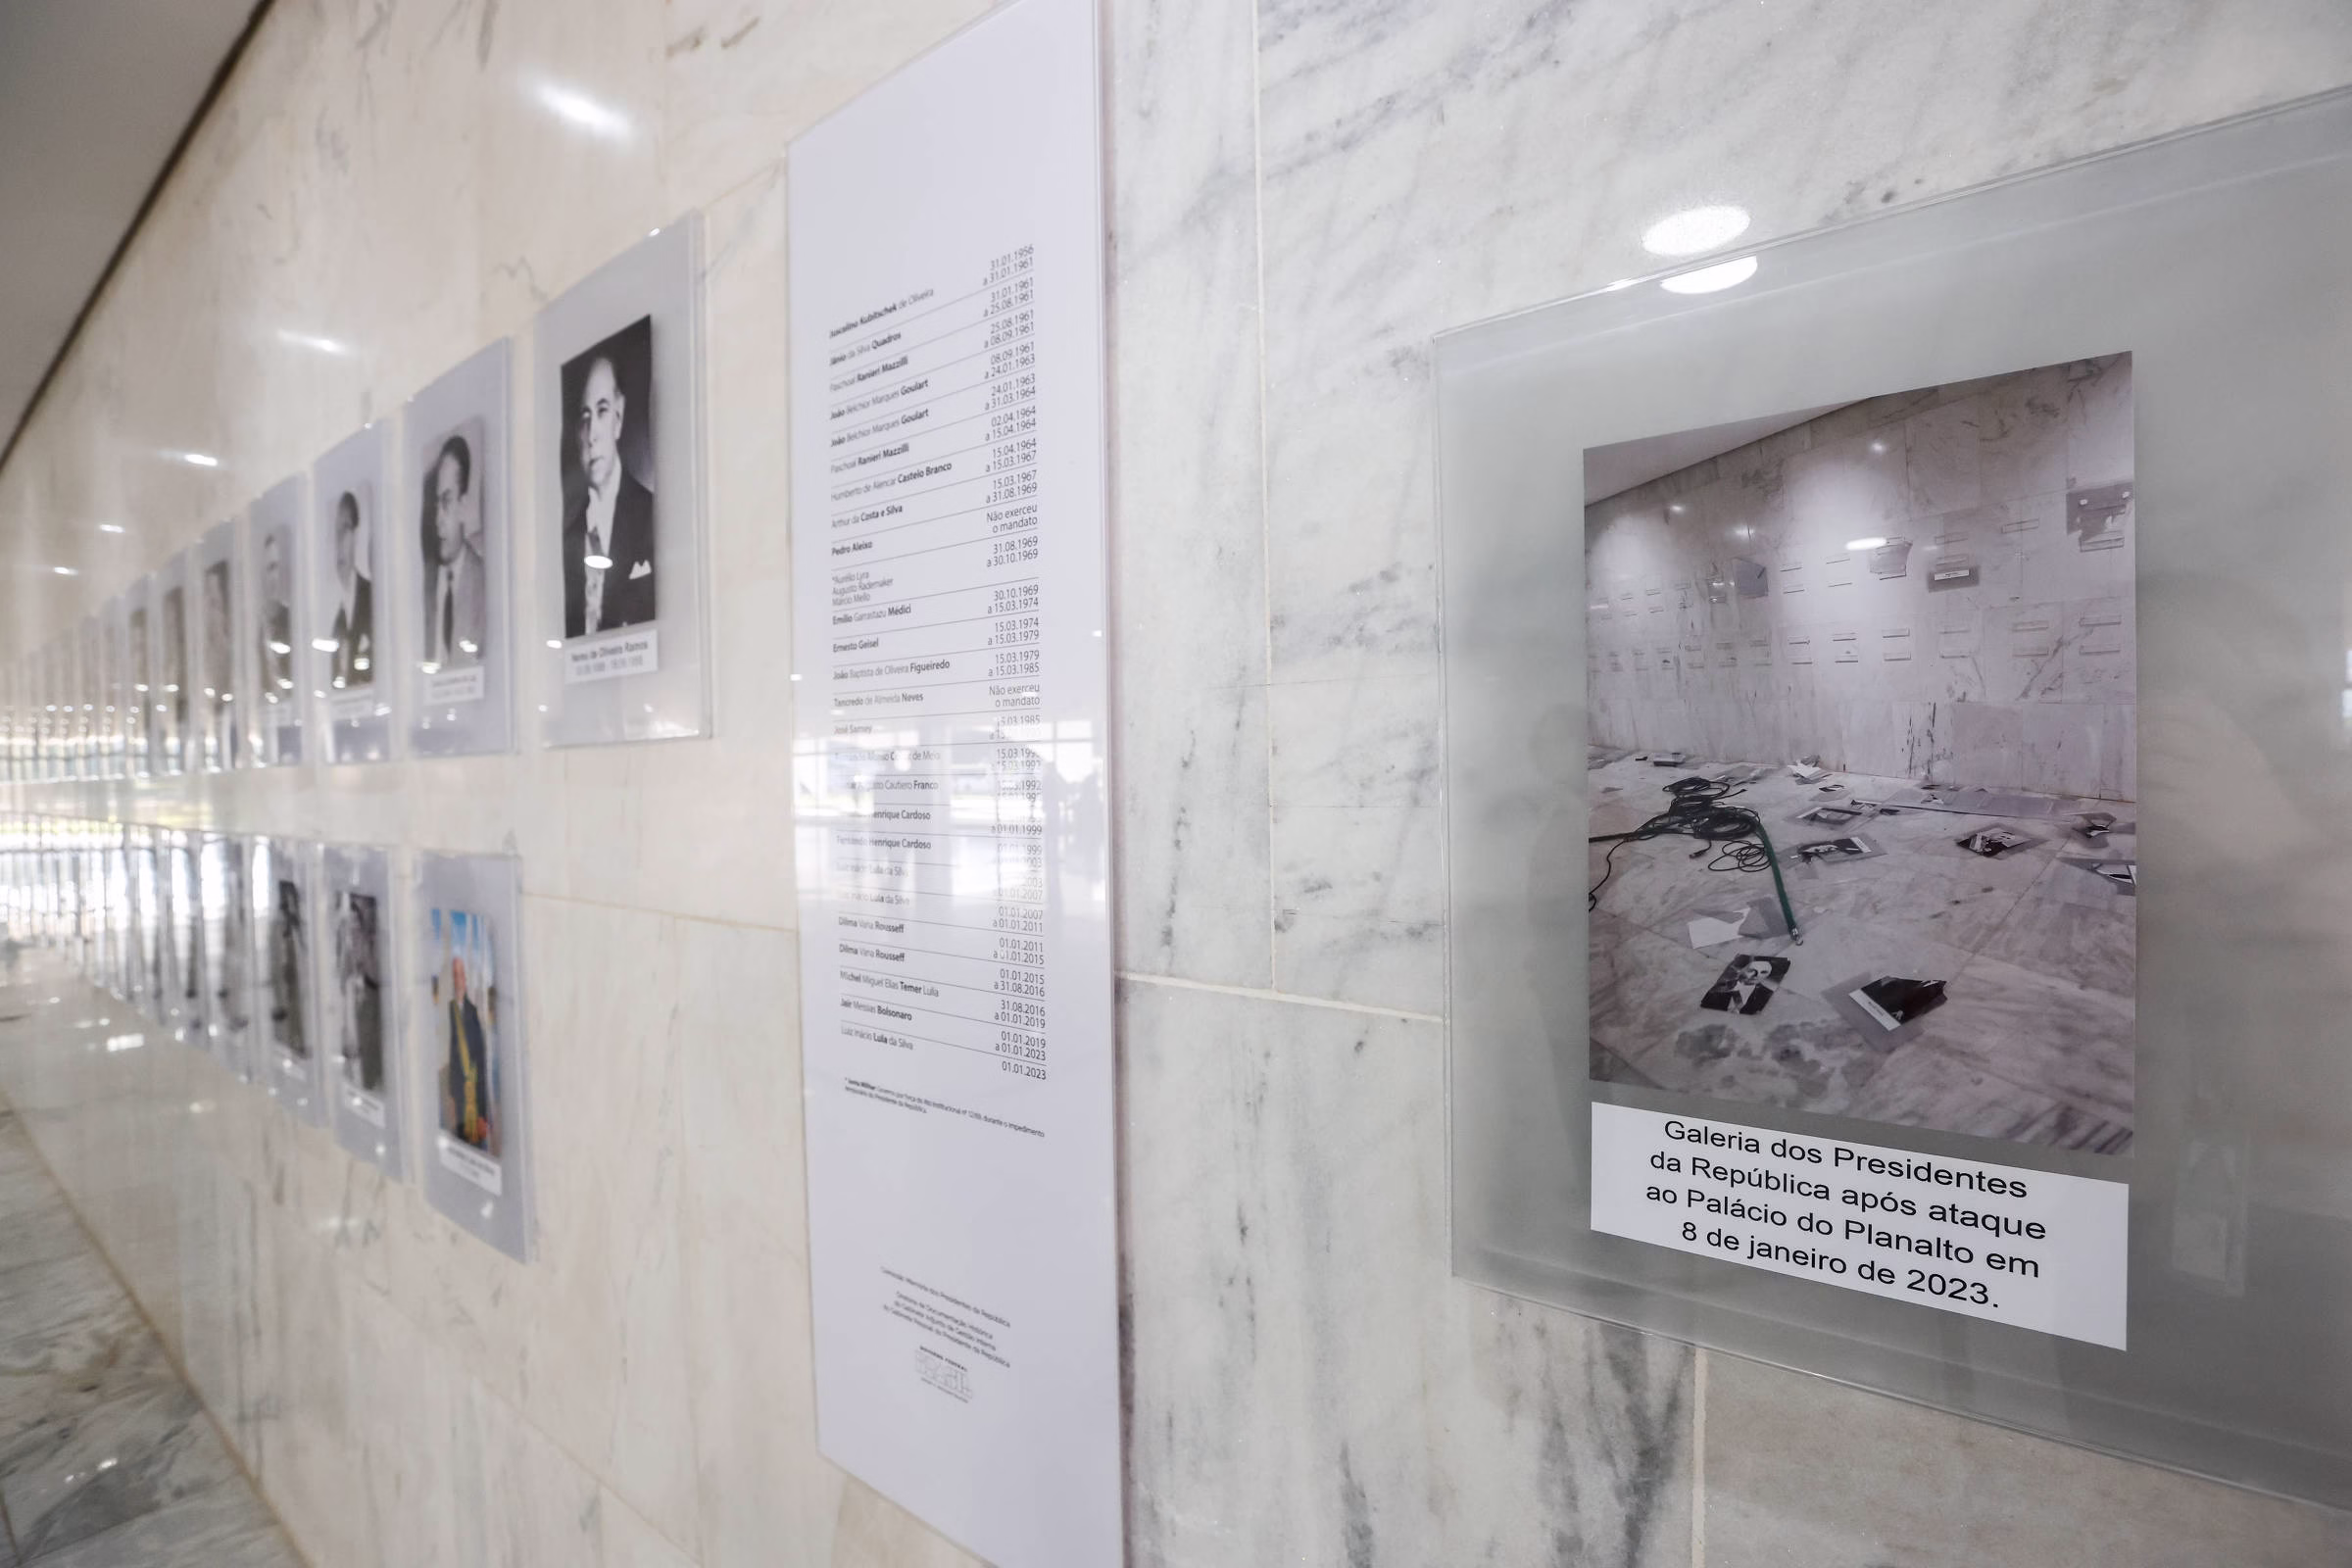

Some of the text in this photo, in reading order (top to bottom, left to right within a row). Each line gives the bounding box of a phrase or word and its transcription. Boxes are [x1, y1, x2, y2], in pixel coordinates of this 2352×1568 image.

[991, 309, 1034, 334] 25.08.1961
[990, 320, 1034, 346] 08.09.1961
[991, 341, 1034, 366] 08.09.1961
[991, 353, 1035, 377] 24.01.1963
[901, 379, 928, 395] Goulart
[991, 372, 1035, 397] 24.01.1963
[991, 385, 1035, 409] 31.03.1964
[902, 408, 929, 424] Goulart
[991, 405, 1036, 427] 02.04.1964
[993, 417, 1036, 439] 15.04.1964
[993, 437, 1037, 459] 15.04.1964
[993, 449, 1037, 470] 15.03.1967
[897, 468, 924, 483] Castelo
[925, 463, 953, 476] Branco
[993, 469, 1037, 490] 15.03.1967
[993, 481, 1037, 503] 31.08.1969
[886, 504, 904, 515] Silva
[987, 504, 1038, 522] Não exerceu
[1000, 516, 1038, 532] mandato
[994, 535, 1038, 555] 31.08.1969
[994, 548, 1039, 566] 30.10.1969
[994, 584, 1039, 602] 30.10.1969
[995, 597, 1039, 612] 15.03.1974
[995, 617, 1039, 633] 15.03.1974
[858, 637, 879, 650] Geisel
[995, 629, 1040, 645] 15.03.1979
[996, 650, 1040, 664] 15.03.1979
[909, 659, 951, 674] Figueiredo
[996, 662, 1040, 676] 15.03.1985
[902, 692, 923, 703] Neves
[989, 684, 1040, 696] Não exerceu
[1003, 696, 1040, 707] mandato
[913, 780, 939, 790] Franco
[872, 809, 931, 820] enrique Cardoso
[902, 838, 932, 850] Cardoso
[999, 906, 1043, 920] 01.01.2007
[874, 920, 905, 933] Rousseff
[999, 918, 1043, 933] 01.01.2011
[999, 937, 1043, 953] 01.01.2011
[875, 949, 906, 961] Rousseff
[1000, 950, 1045, 965] 01.01.2015
[1000, 968, 1045, 985] 01.01.2015
[900, 981, 922, 994] Temer
[1000, 980, 1045, 997] 31.08.2016
[877, 1005, 912, 1021] Bolsonaro
[1001, 999, 1046, 1016] 31.08.2016
[1001, 1011, 1046, 1029] 01.01.2019
[873, 1033, 888, 1044] Lula
[1001, 1030, 1046, 1049] 01.01.2019
[1001, 1042, 1046, 1060] 01.01.2023
[1002, 1060, 1047, 1080] 01.01.2023
[1664, 1120, 2028, 1199] Galeria dos Presidentes
[1650, 1151, 2046, 1240] da República após ataque
[1646, 1185, 2039, 1278] ao Palácio do Planalto em
[1682, 1221, 1998, 1308] 8 de janeiro de 2023.
